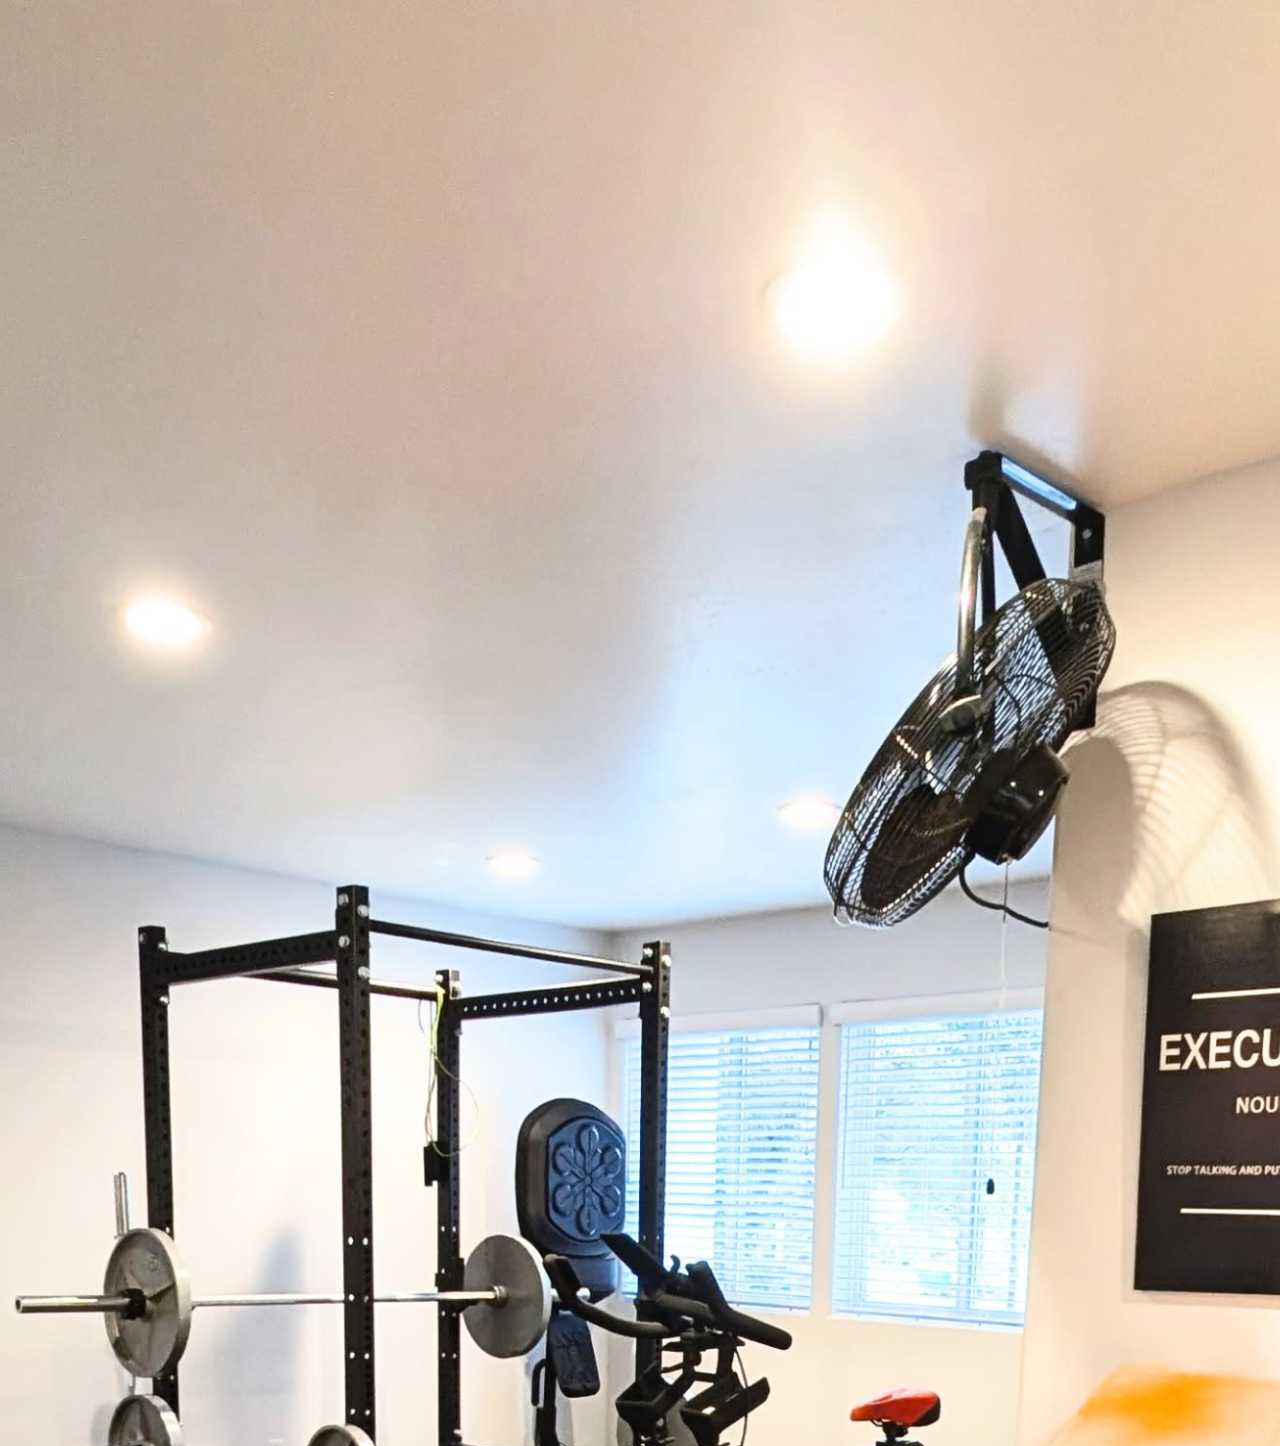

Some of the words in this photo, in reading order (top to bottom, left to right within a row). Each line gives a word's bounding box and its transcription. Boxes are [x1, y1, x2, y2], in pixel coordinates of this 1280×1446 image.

[1166, 1164, 1192, 1176] STOP
[1193, 1164, 1237, 1176] TALKING
[1238, 1164, 1263, 1176] AND
